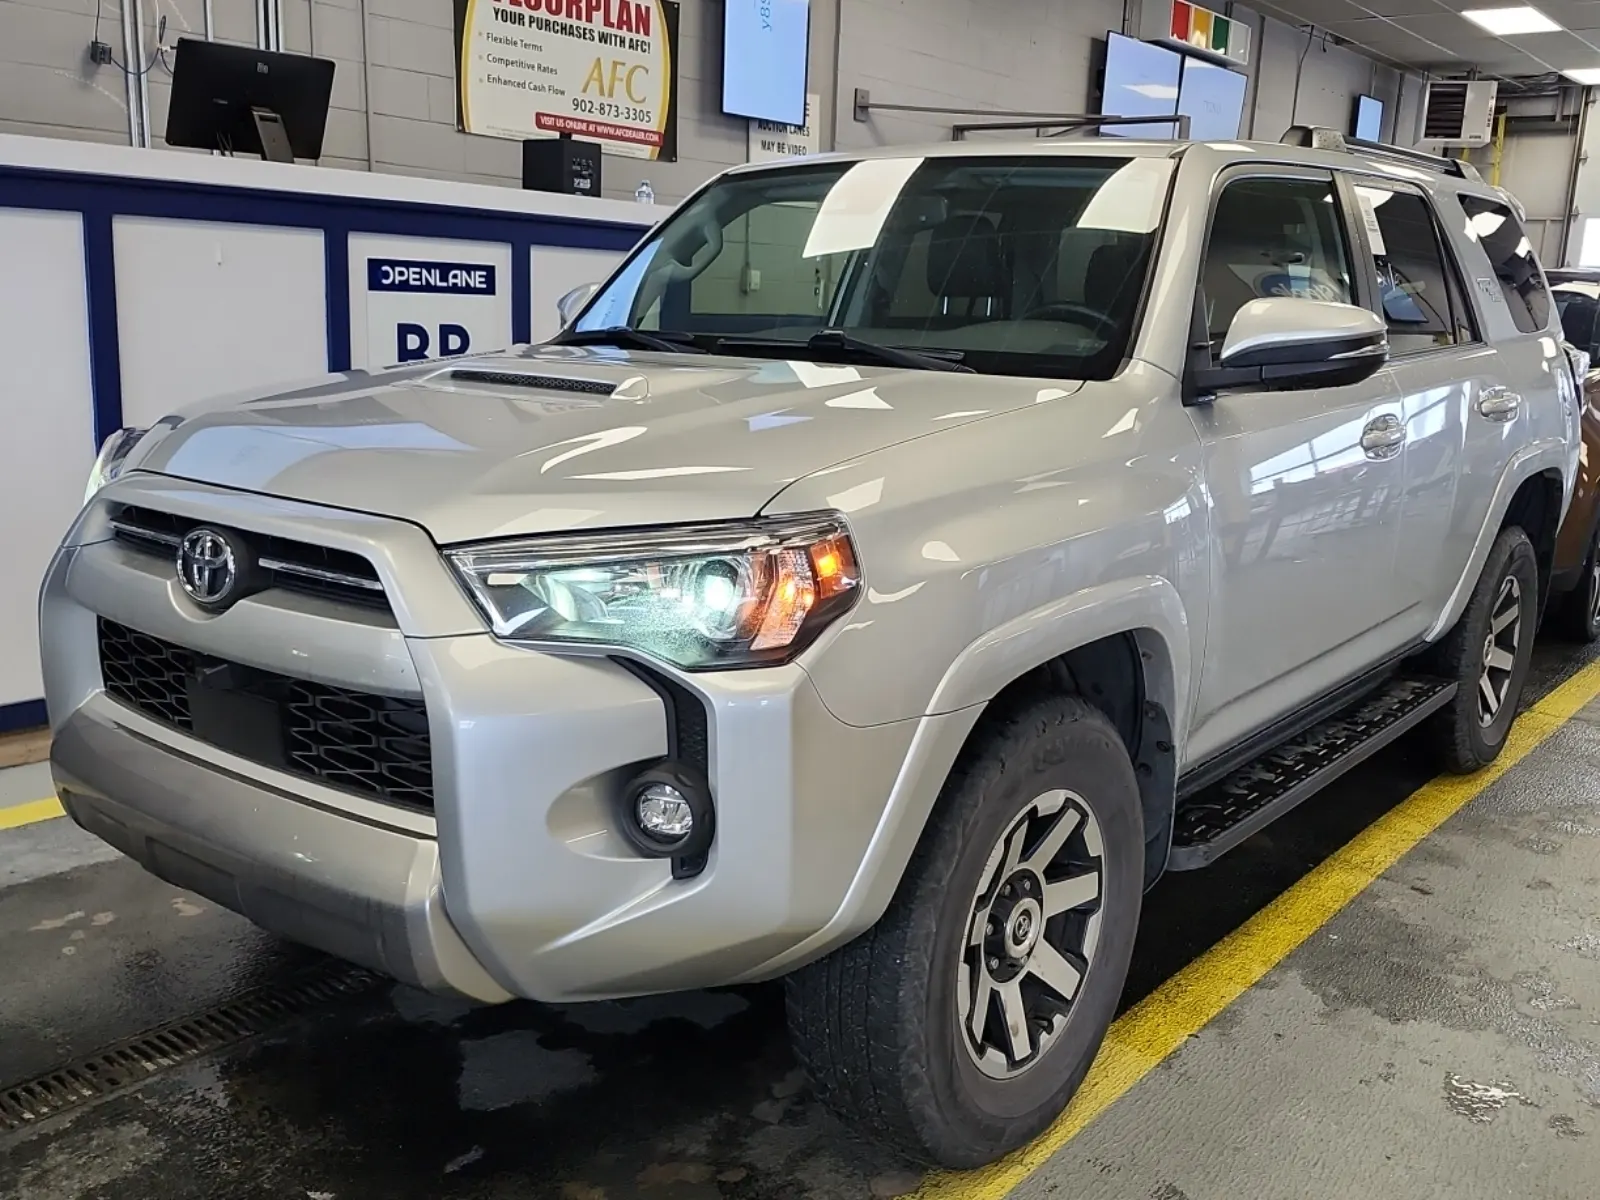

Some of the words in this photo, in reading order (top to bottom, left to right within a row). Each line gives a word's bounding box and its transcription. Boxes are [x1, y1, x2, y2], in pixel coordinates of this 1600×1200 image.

[493, 0, 651, 36] ORPLAN
[486, 32, 519, 48] Flexible
[519, 39, 543, 52] Terms
[493, 7, 525, 27] YOUR
[528, 14, 596, 42] PURCHASES
[598, 30, 626, 49] WITH
[628, 37, 652, 54] AFC!
[486, 53, 535, 71] Competitive
[536, 63, 558, 75] Rates
[487, 74, 526, 90] Enhanced
[527, 81, 547, 93] Cash
[547, 85, 566, 96] Flow
[581, 57, 649, 104] AFC
[572, 97, 652, 124] 902-873-3305
[540, 116, 555, 126] VISIT
[556, 118, 565, 128] US
[565, 119, 588, 132] ONLINE
[588, 124, 597, 133] AT
[761, 139, 776, 152] MAY
[777, 142, 786, 154] BE
[787, 143, 807, 156] VIDEO
[380, 265, 487, 289] OPENLANE
